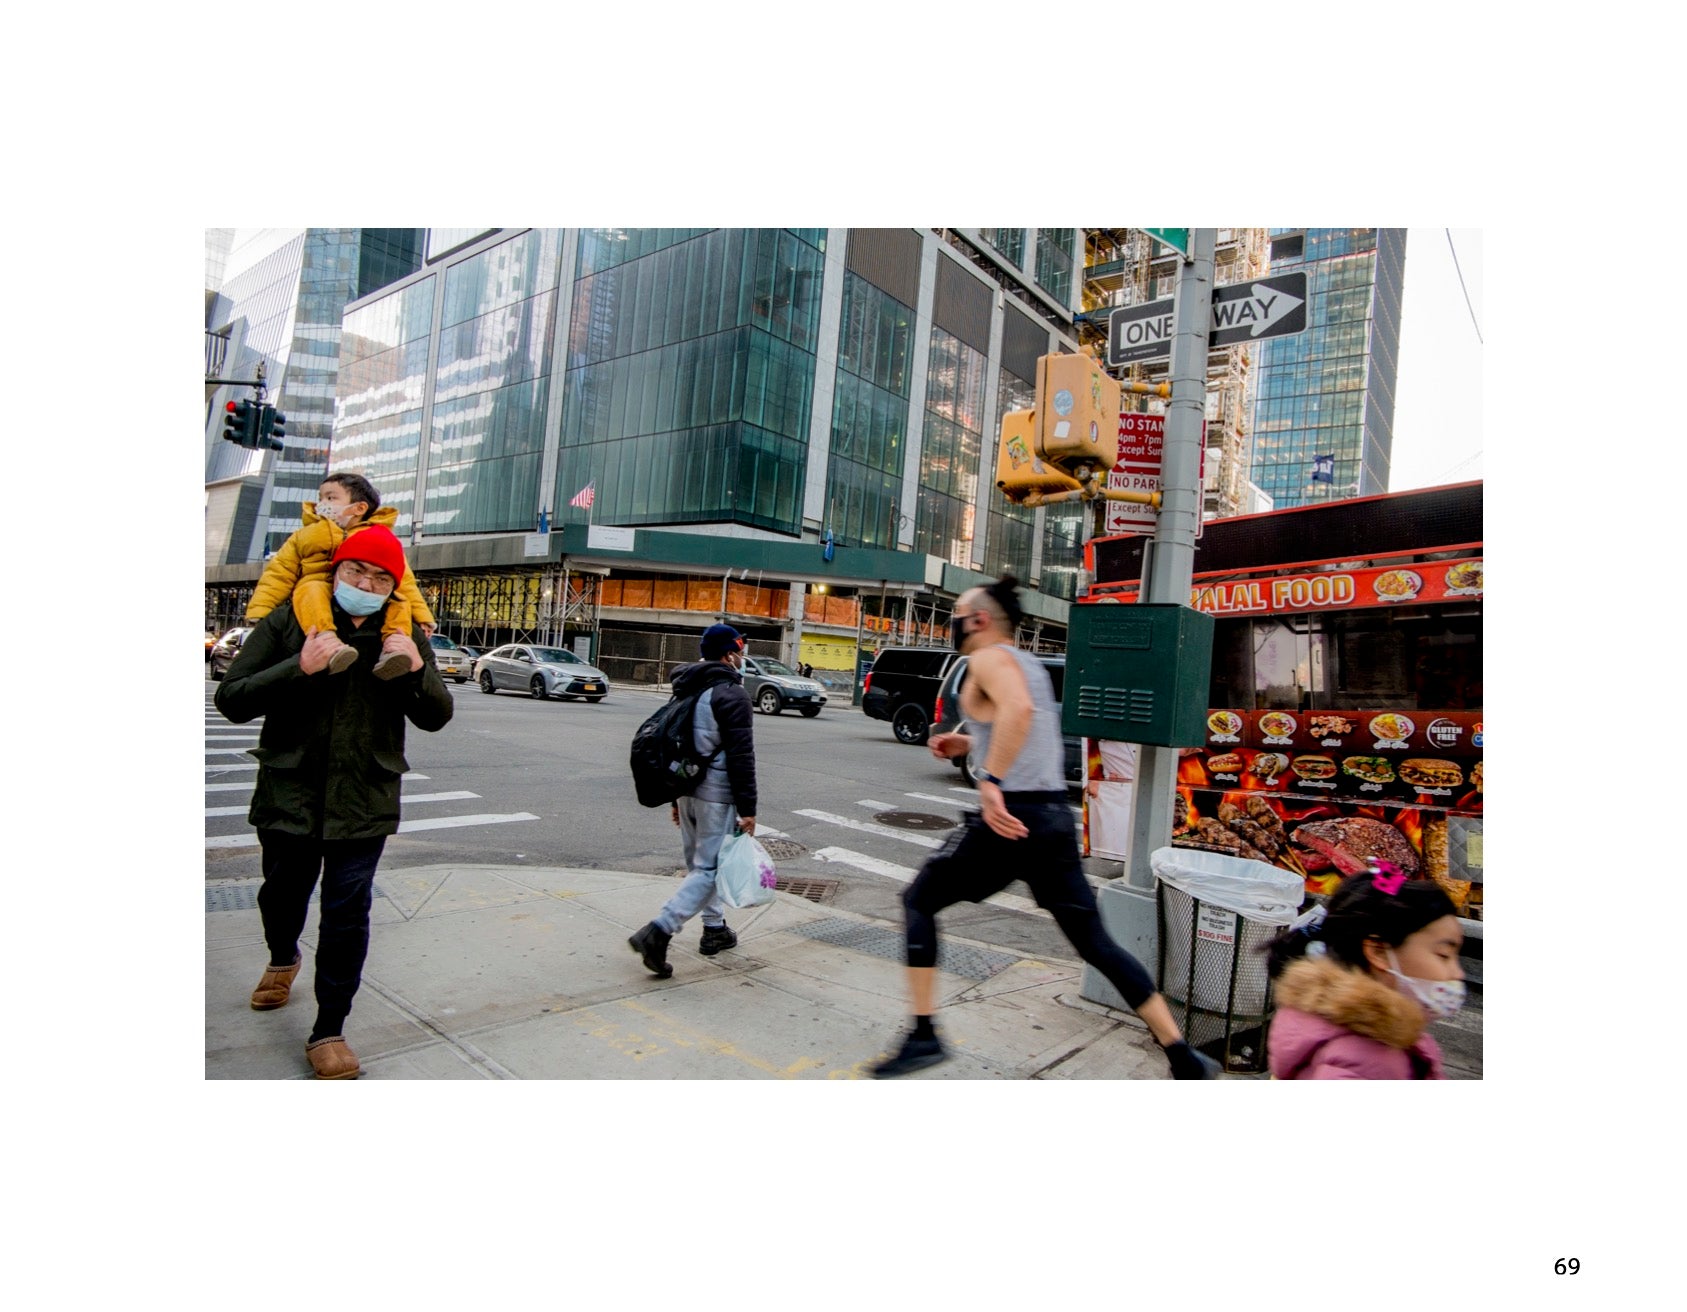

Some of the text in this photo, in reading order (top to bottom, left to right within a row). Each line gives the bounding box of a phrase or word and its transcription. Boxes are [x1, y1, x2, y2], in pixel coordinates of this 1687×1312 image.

[1127, 295, 1278, 344] ONE WAY
[1119, 418, 1134, 430] NO
[1119, 433, 1136, 444] 4pm
[1144, 434, 1162, 446] 7pm
[1117, 444, 1145, 456] Except
[1114, 477, 1130, 488] NO
[1112, 503, 1141, 514] Except
[1272, 575, 1355, 609] FOOD
[1431, 726, 1463, 734] GLUTEN
[1217, 933, 1233, 942] FINE
